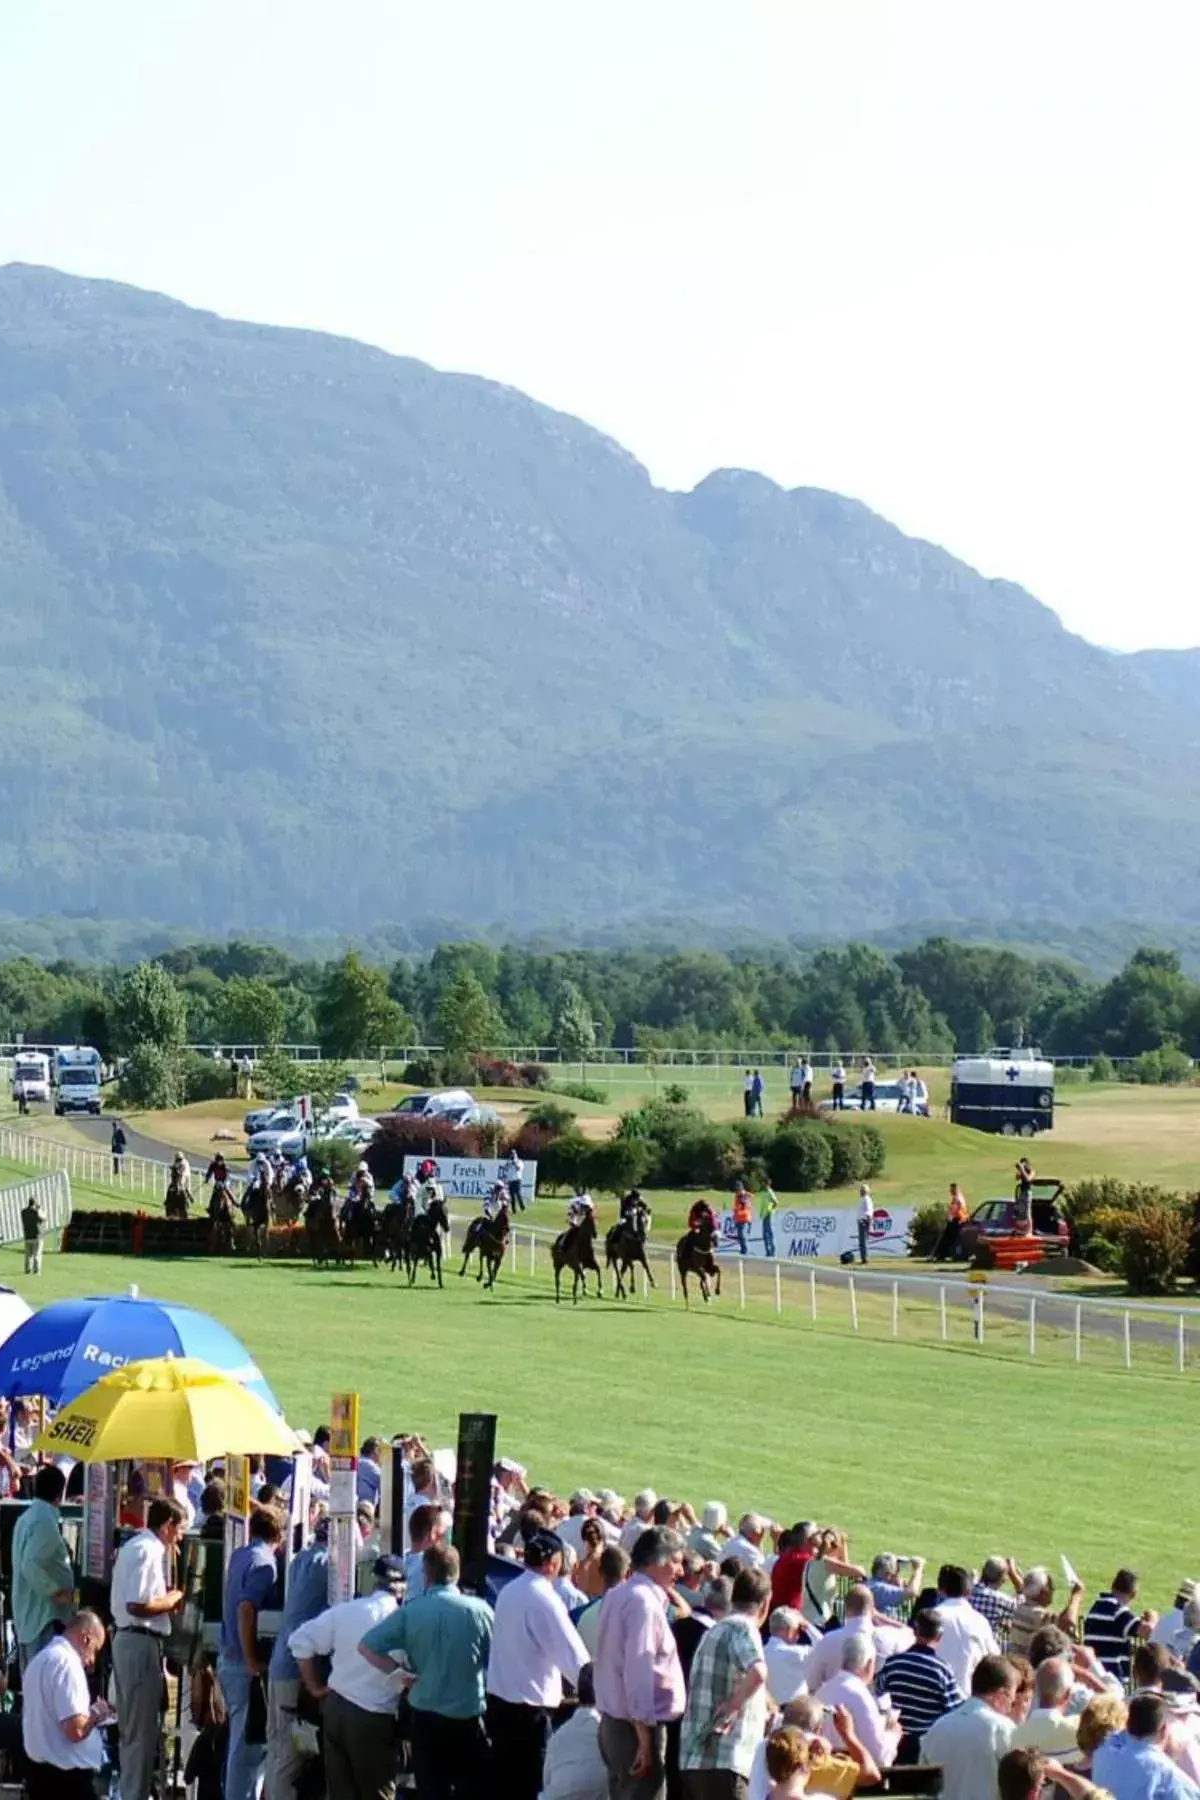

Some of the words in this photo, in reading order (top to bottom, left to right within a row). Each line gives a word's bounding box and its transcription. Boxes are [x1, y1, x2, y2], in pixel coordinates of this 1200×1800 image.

[452, 1164, 486, 1177] Fresh
[450, 1181, 485, 1196] Milk
[783, 1211, 836, 1237] Omega
[787, 1238, 820, 1257] Milk
[11, 1342, 76, 1372] Legend
[83, 1343, 130, 1368] Raci
[48, 1421, 96, 1447] SHEIL
